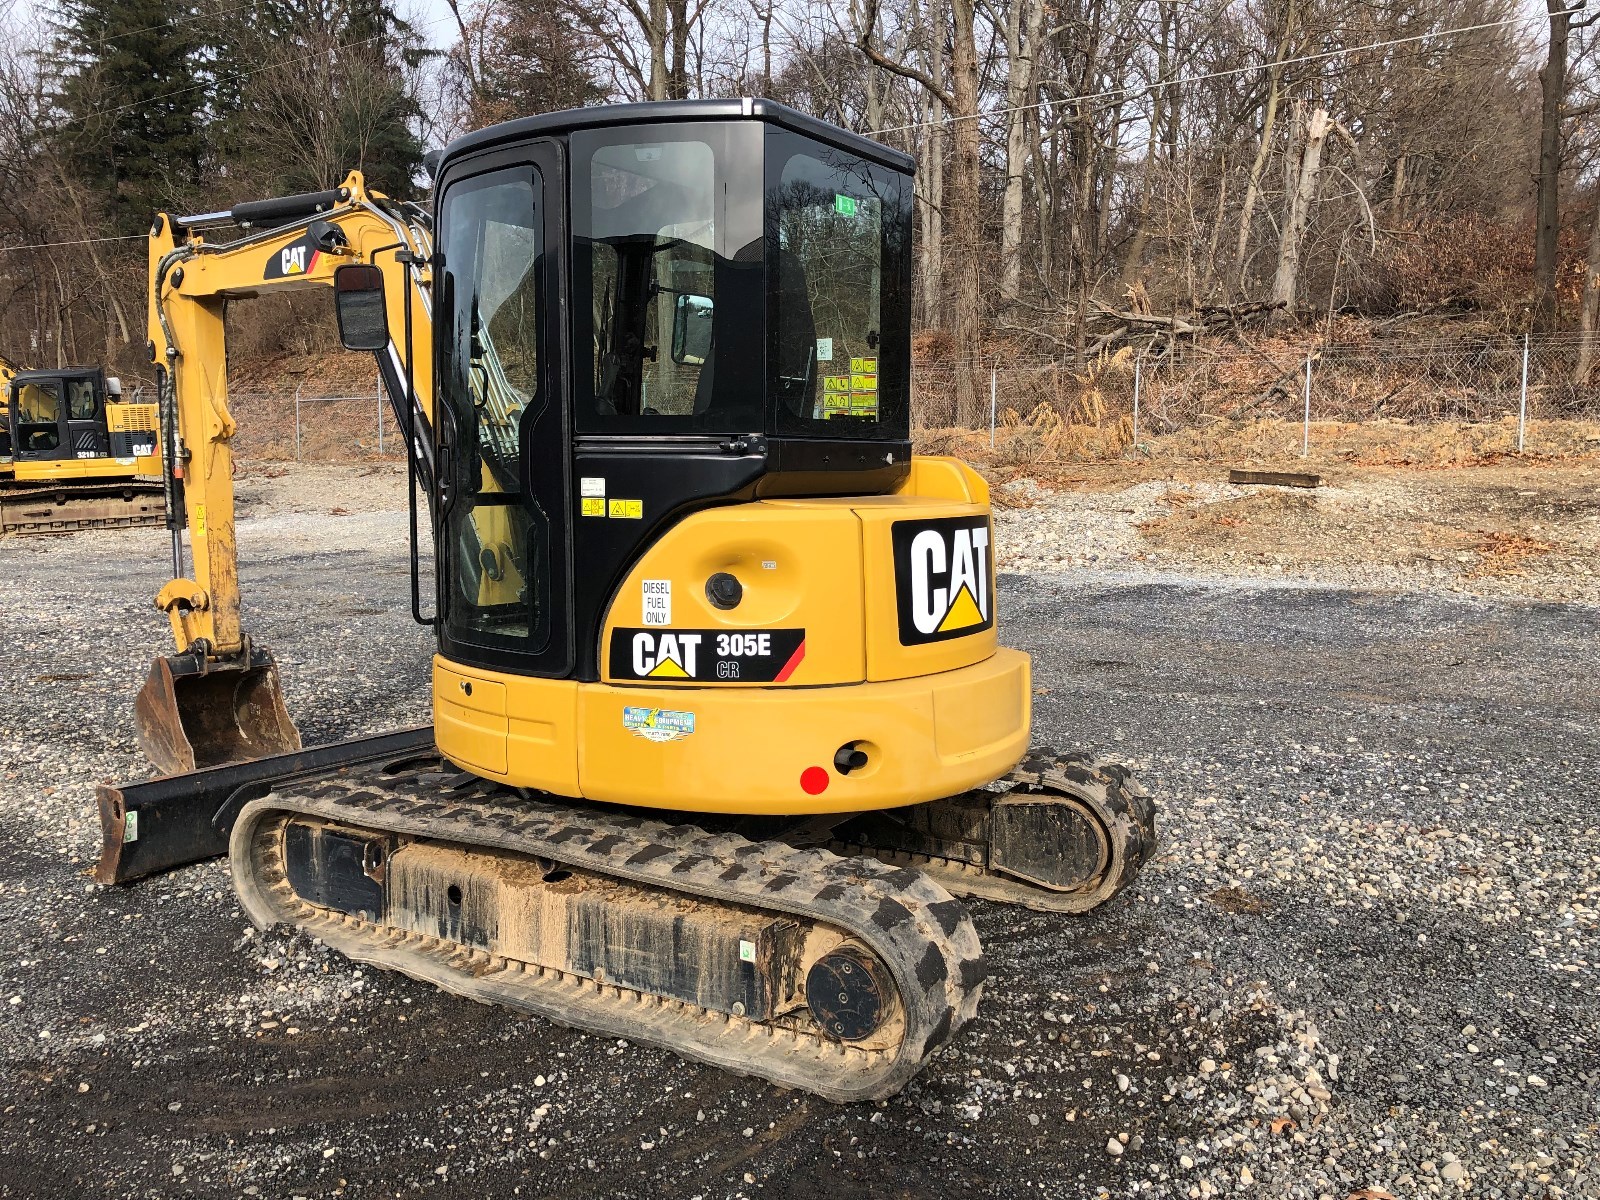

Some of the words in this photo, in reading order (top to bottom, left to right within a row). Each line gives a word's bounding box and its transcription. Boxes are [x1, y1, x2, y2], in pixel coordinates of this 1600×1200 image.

[281, 246, 306, 275] CAT
[132, 444, 152, 456] CAT
[911, 527, 988, 634] CAT
[643, 582, 670, 594] DIESEL
[647, 597, 666, 609] FUEL
[646, 612, 667, 624] ONLY
[716, 633, 771, 656] 305E
[632, 632, 702, 678] CAT
[716, 661, 740, 678] CR
[624, 713, 646, 722] HEAVY
